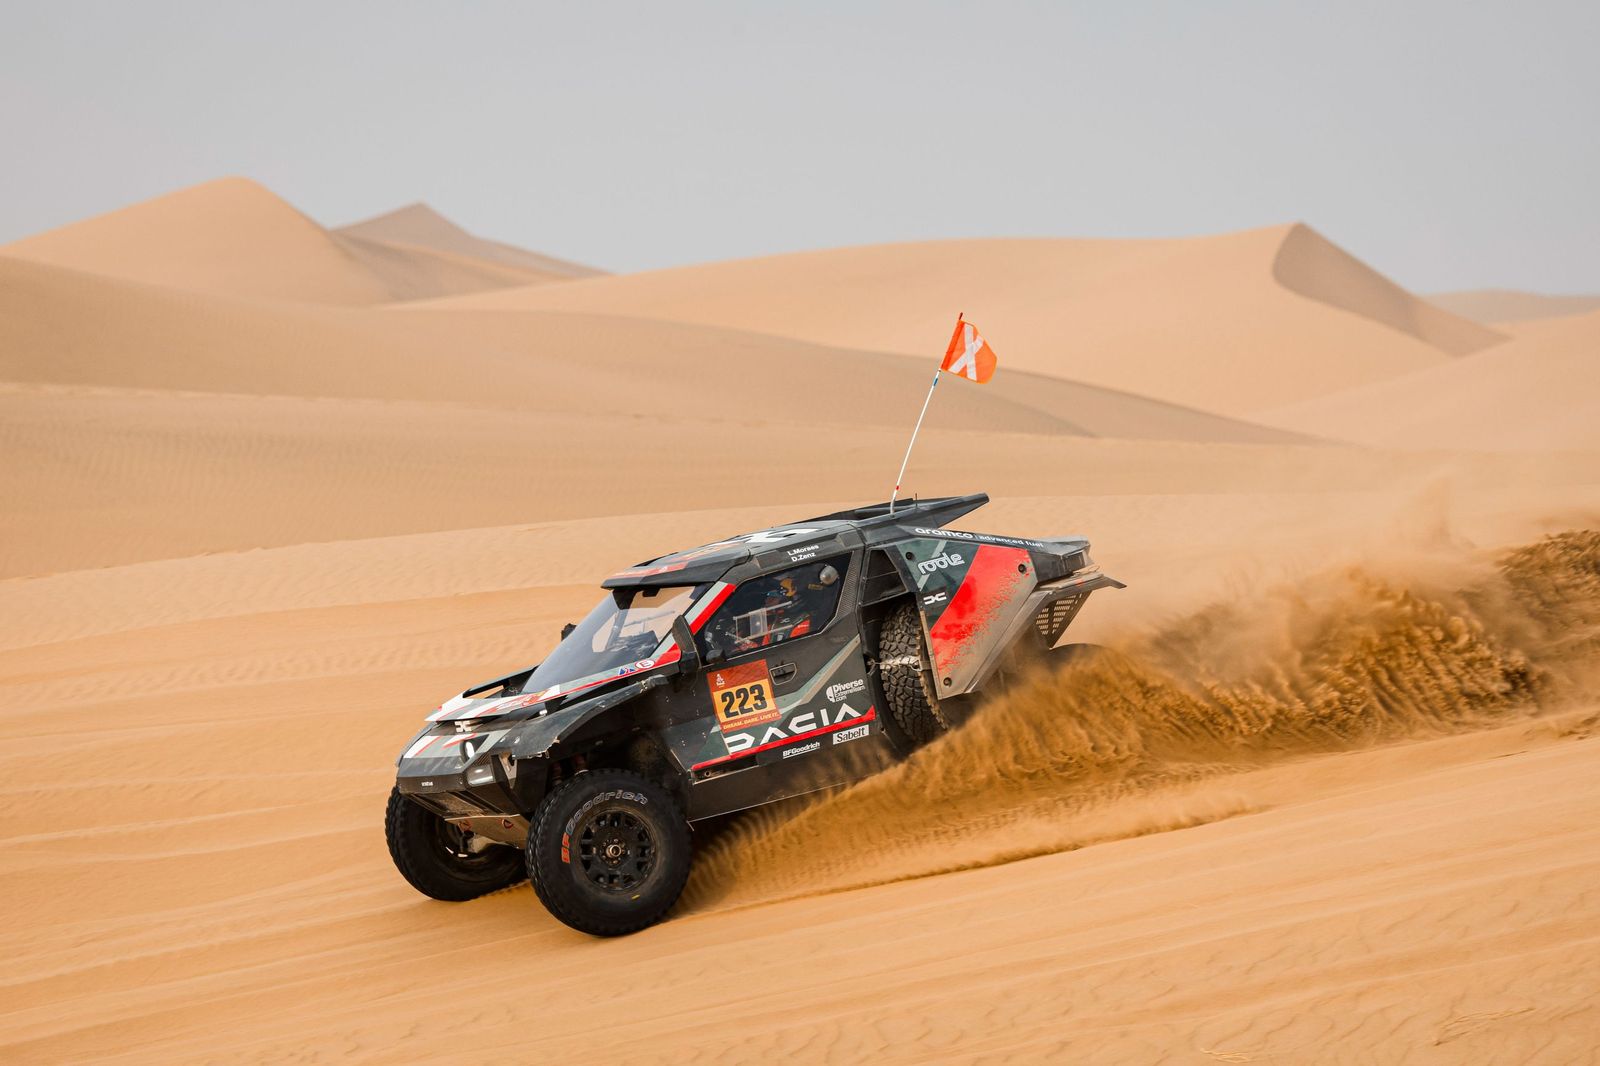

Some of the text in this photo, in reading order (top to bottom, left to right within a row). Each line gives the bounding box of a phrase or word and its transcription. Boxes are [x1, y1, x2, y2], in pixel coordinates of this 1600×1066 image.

[915, 528, 1044, 548] aramco advanced fuel
[787, 545, 819, 556] L.Moraes
[791, 552, 816, 562] D.Zenz
[917, 552, 965, 574] roole
[833, 678, 864, 693] Diverse
[720, 684, 768, 719] 223
[724, 703, 862, 753] DACIA
[837, 727, 865, 742] Sabelt
[782, 741, 820, 757] BFGoodrich
